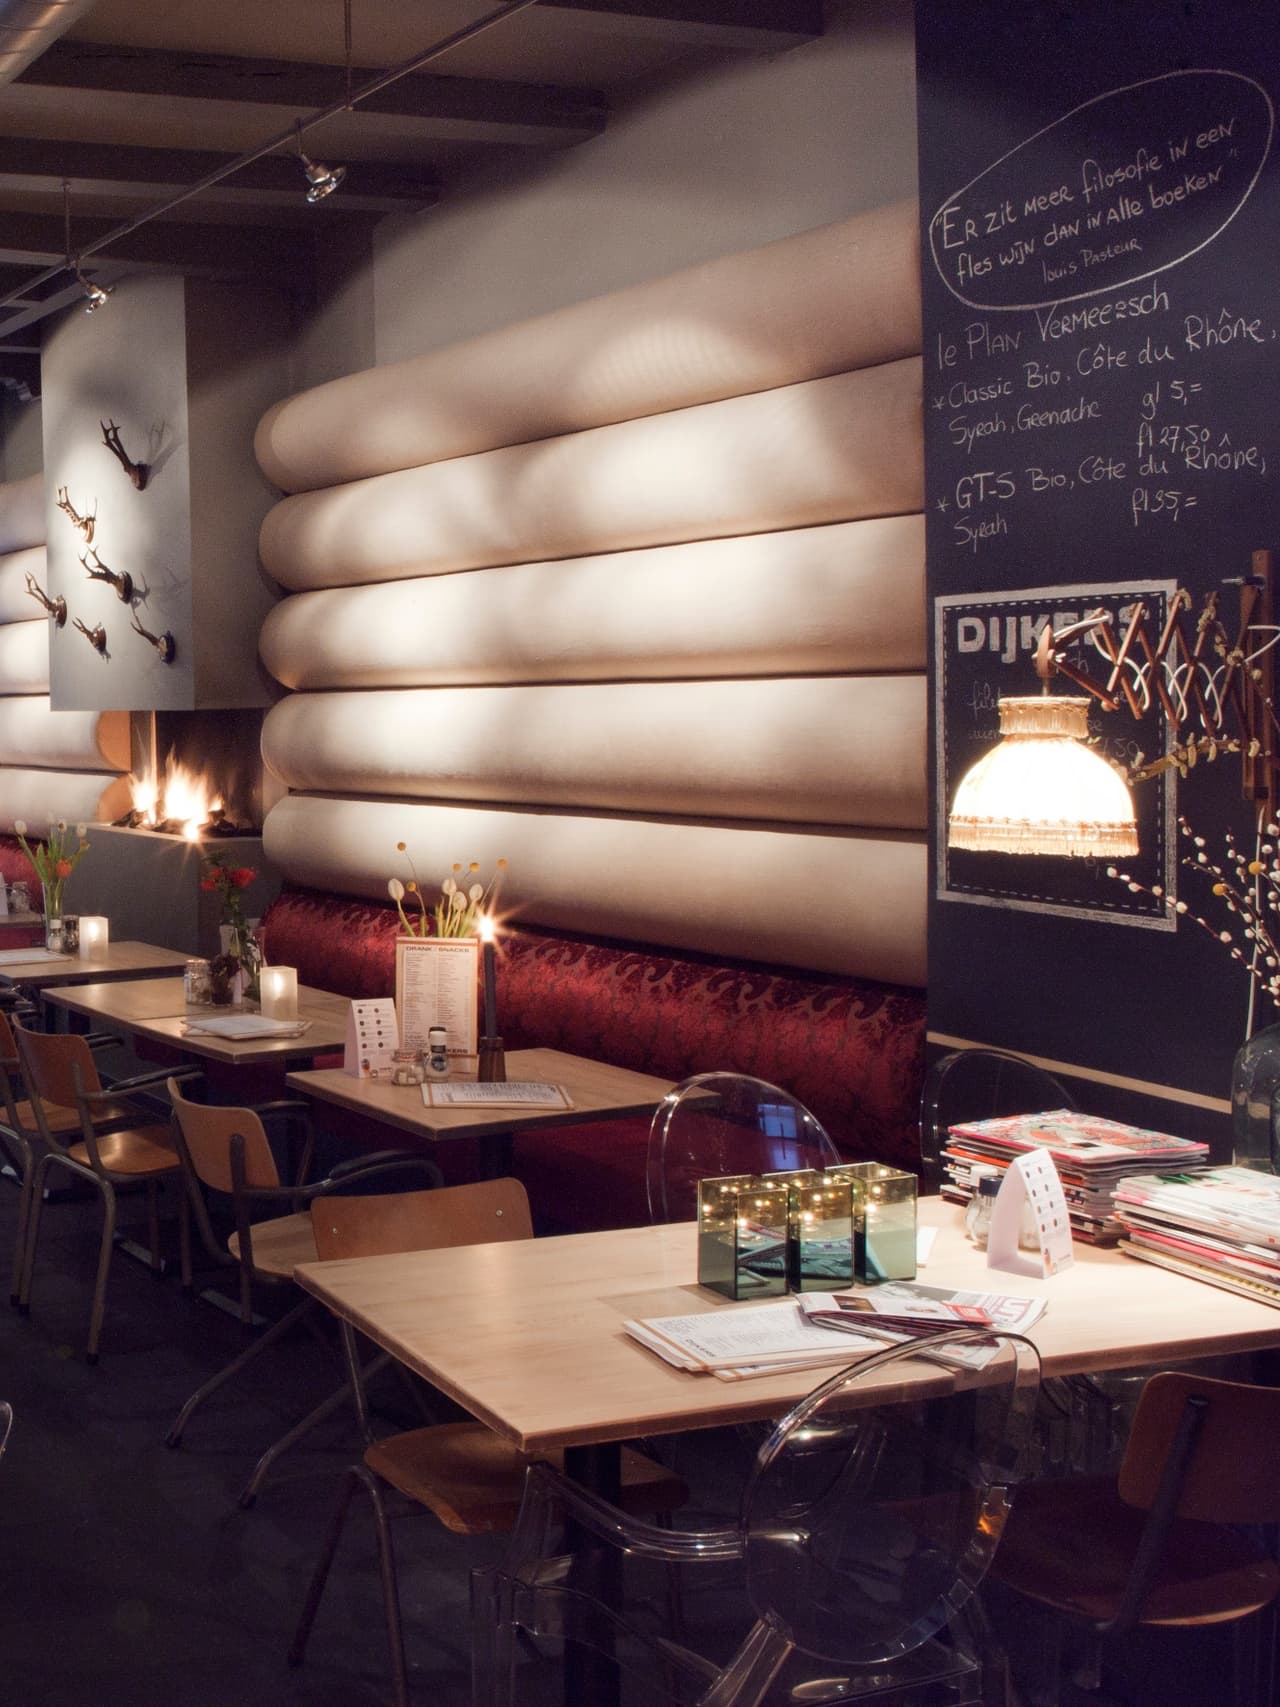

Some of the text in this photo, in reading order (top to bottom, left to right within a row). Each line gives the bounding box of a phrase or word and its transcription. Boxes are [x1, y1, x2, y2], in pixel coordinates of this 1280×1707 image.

[1082, 148, 1162, 203] filosofie
[957, 252, 992, 286] fles
[1077, 343, 1129, 376] Côte
[1138, 337, 1175, 365] du
[1159, 424, 1210, 454] 27,50
[1078, 455, 1127, 484] Côte
[1138, 453, 1169, 476] du
